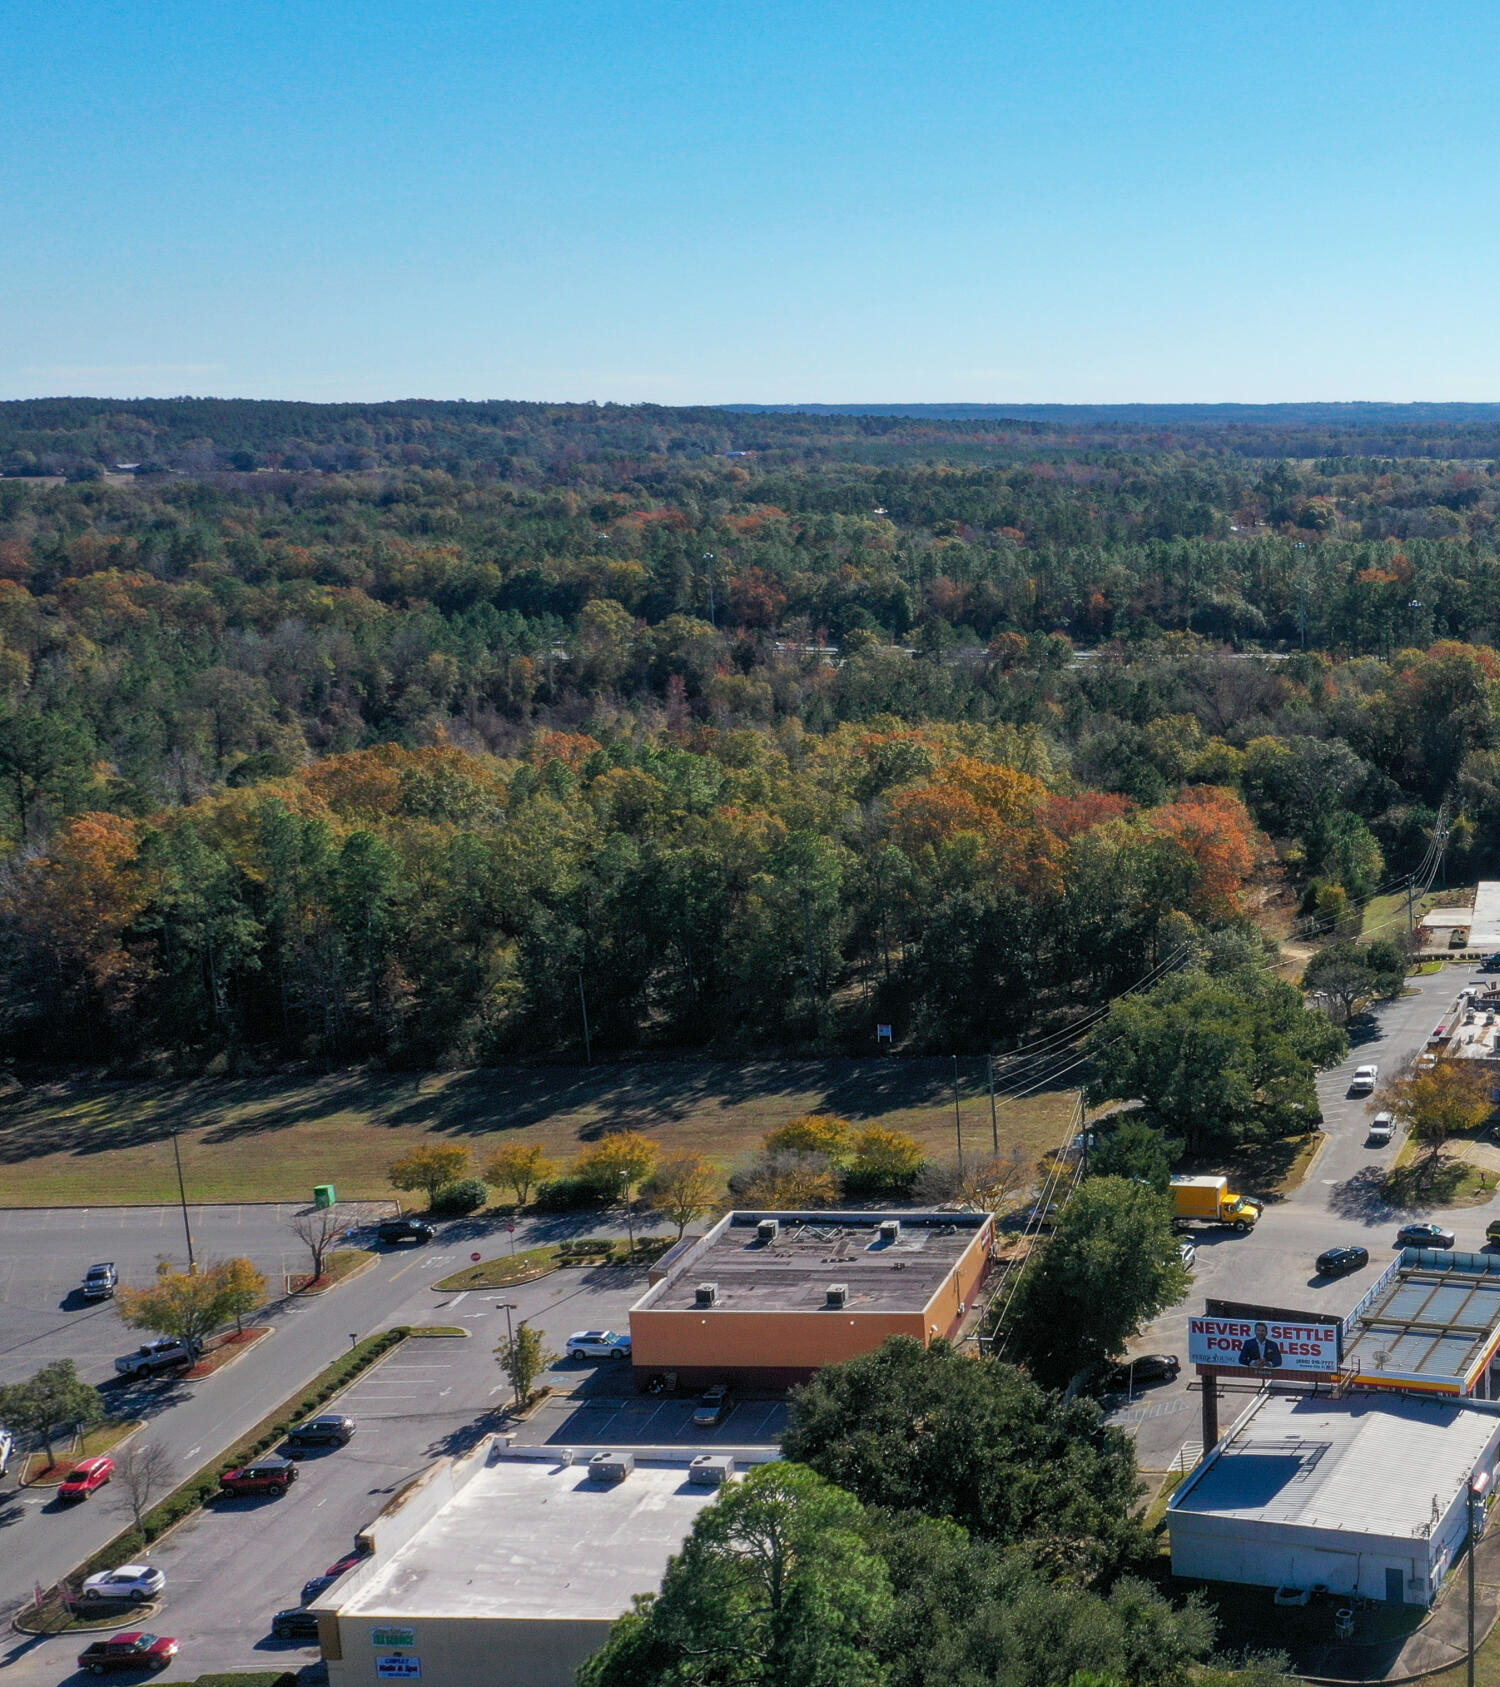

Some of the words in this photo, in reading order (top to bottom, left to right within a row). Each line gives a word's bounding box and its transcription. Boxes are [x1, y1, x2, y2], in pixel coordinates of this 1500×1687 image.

[1191, 1320, 1251, 1336] NEVER
[1271, 1325, 1334, 1342] SETTLE
[1207, 1337, 1243, 1351] FOR
[1279, 1342, 1322, 1357] LESS
